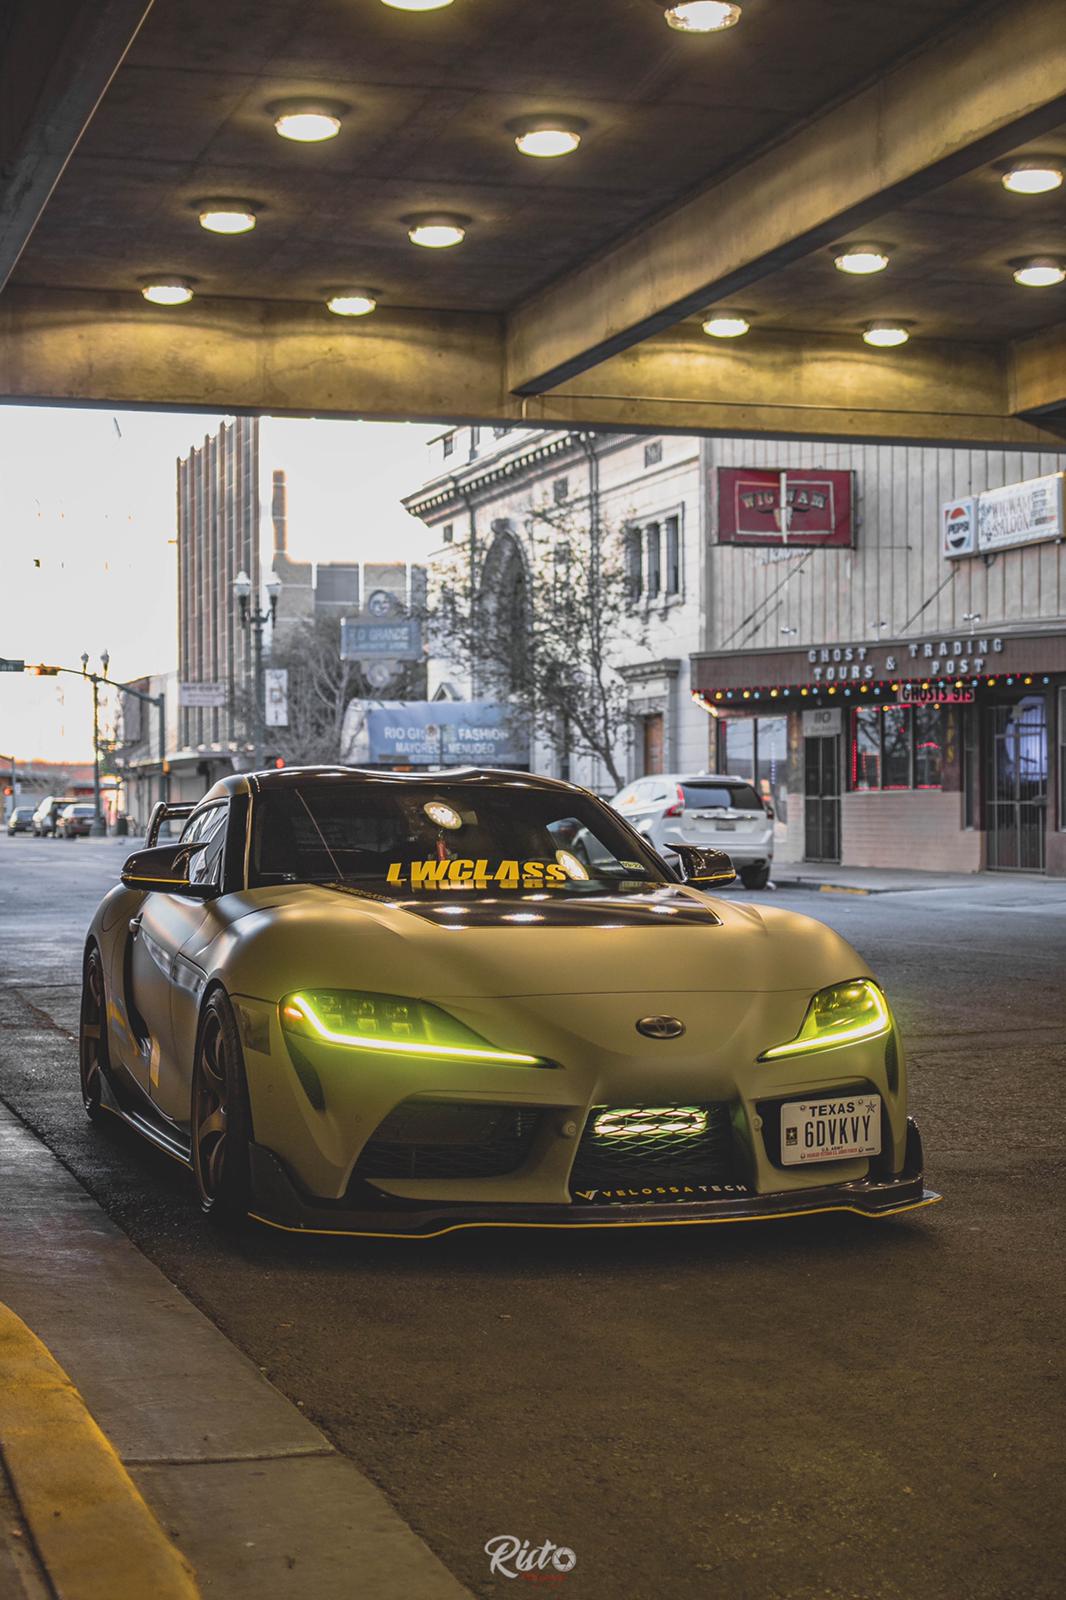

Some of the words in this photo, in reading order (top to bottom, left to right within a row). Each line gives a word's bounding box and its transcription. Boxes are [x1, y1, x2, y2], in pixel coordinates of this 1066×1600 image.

[947, 521, 970, 536] PEPSI
[807, 647, 868, 664] GHOST
[908, 638, 1004, 658] TRADING
[886, 655, 897, 671] &
[931, 658, 986, 676] POST
[813, 664, 875, 681] TOURS
[902, 686, 948, 702] GHOSTS
[814, 711, 832, 724] 110
[384, 726, 405, 740] RIO
[809, 1102, 855, 1117] TEXAS
[804, 1115, 871, 1148] 6DVKVY
[602, 1185, 694, 1198] VELOSSA
[698, 1184, 748, 1193] TECH
